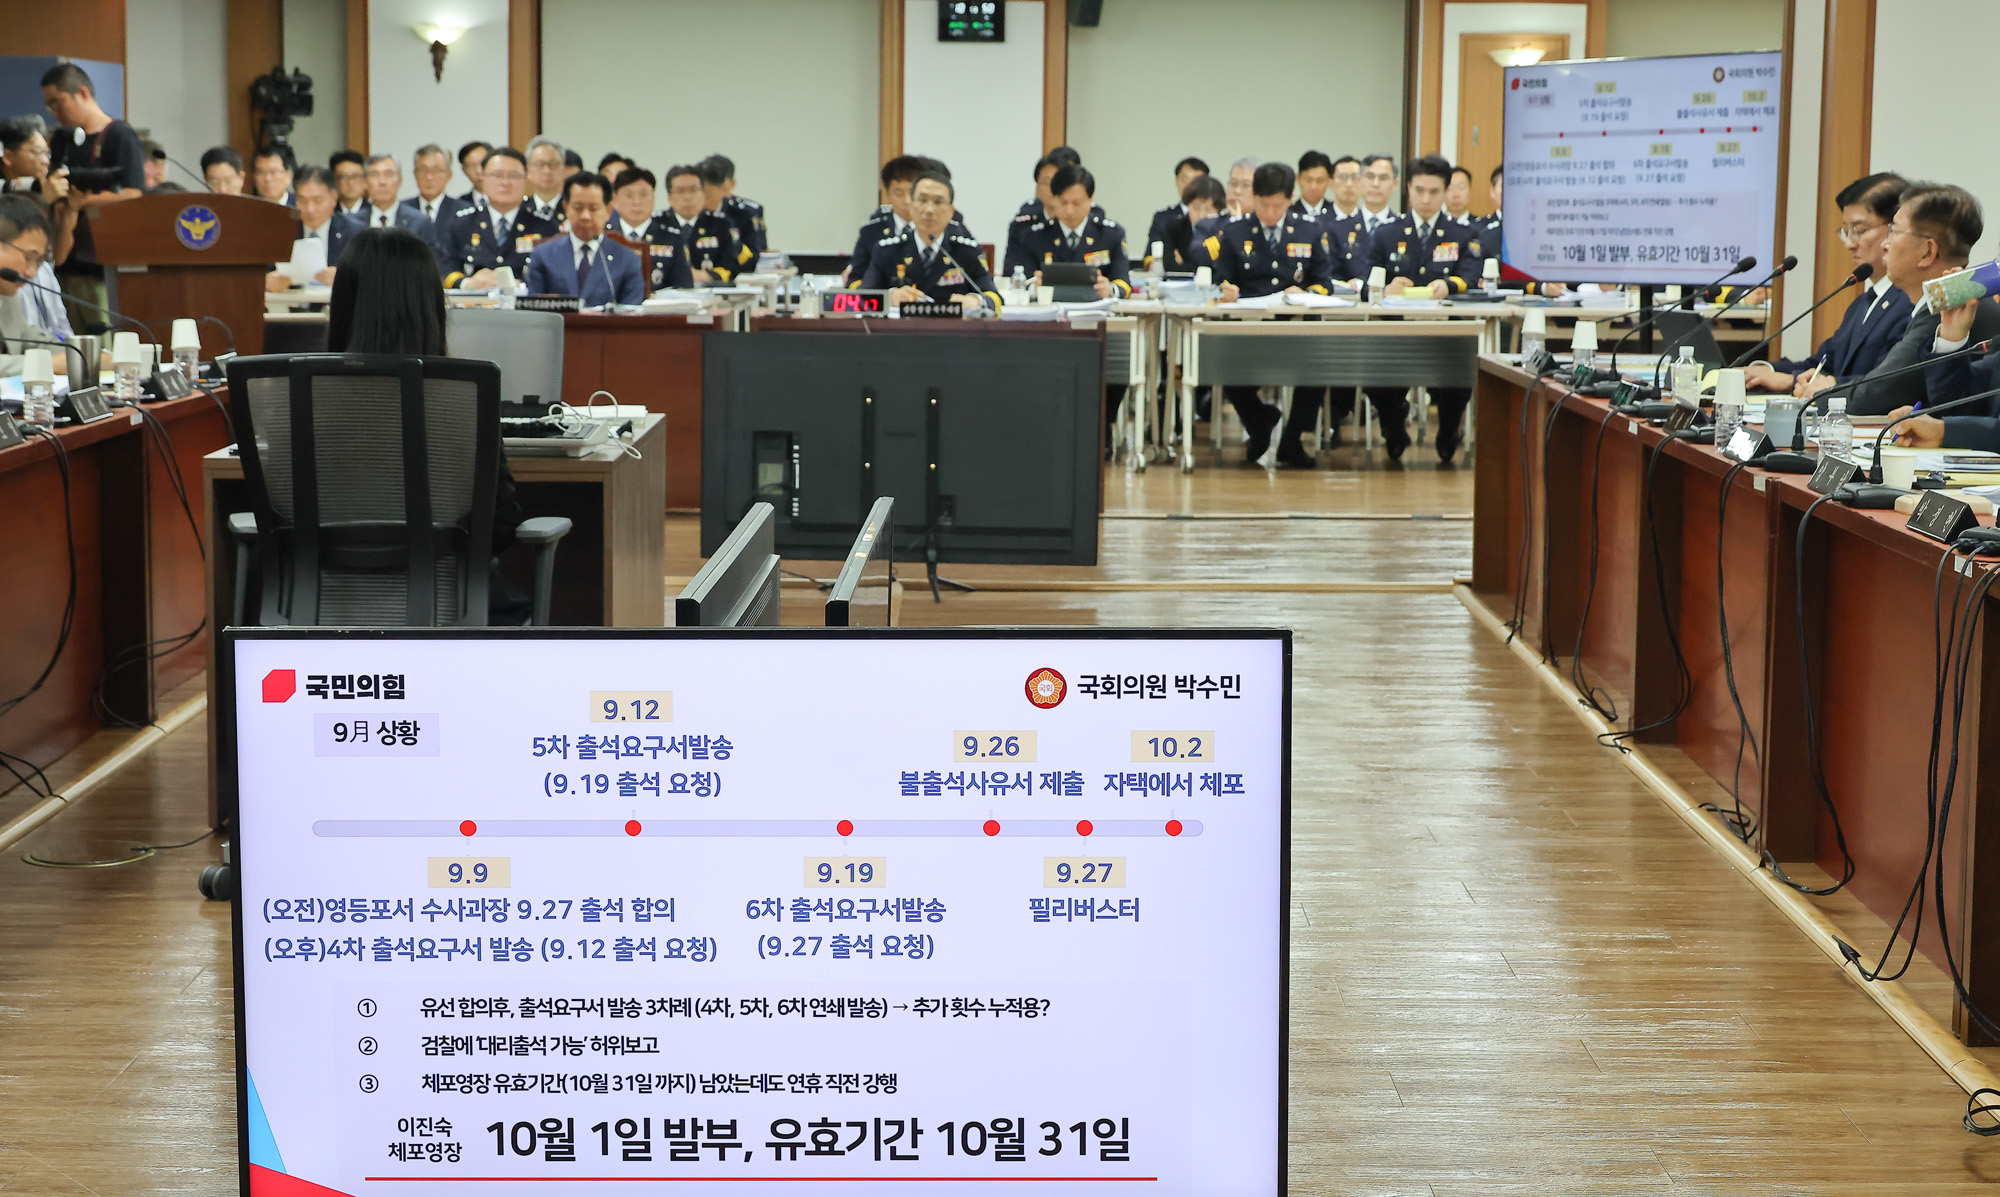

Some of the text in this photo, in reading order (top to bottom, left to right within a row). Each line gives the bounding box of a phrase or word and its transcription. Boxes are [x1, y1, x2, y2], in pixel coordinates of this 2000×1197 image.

[1563, 244, 1586, 262] 10월
[1590, 244, 1606, 262] 1일
[1637, 244, 1681, 263] 유효기간
[1685, 245, 1711, 263] 10월
[1714, 245, 1741, 264] 31일
[305, 673, 405, 700] 국민의힘
[1077, 674, 1241, 700] 국회의원 박수민
[603, 699, 660, 721] 9.12
[376, 719, 421, 746] 상황
[532, 733, 734, 761] 5차 출석요구서발송
[963, 735, 1020, 758] 9.26
[1148, 737, 1203, 759] 10.2
[544, 770, 722, 798] (9.19 출석 요청)
[898, 770, 1085, 797] 불출석사유서 제출
[1103, 771, 1246, 798] 자택에서 체포
[448, 862, 488, 884] 9.9
[817, 862, 874, 884] 9.19
[1056, 862, 1113, 884] 9.27
[263, 896, 675, 924] (오전)영등포서 수사과장 9.27 출석 합의
[746, 896, 947, 923] 6차 출석요구서발송
[1029, 897, 1140, 923] 필리버스터
[264, 936, 717, 963] (오후)4차 출석요구서 발송 (9.12 출석 요청)
[757, 933, 934, 960] (9.27 출석 요청)
[419, 997, 455, 1018] 유선
[457, 996, 515, 1019] 합의후,
[518, 996, 604, 1019] 출석요구서
[607, 997, 643, 1019] 발송
[645, 997, 692, 1018] 3차례
[694, 997, 735, 1019] (4차,
[739, 997, 773, 1019] 5차,
[777, 997, 808, 1018] 6차
[809, 997, 845, 1018] 연쇄
[847, 997, 888, 1019] 발송)
[912, 996, 949, 1018] 추가
[950, 996, 987, 1018] 횟수
[987, 997, 1051, 1019] 누적용?
[421, 1034, 474, 1057] 검찰에
[589, 1035, 660, 1056] 허위보고
[421, 1073, 492, 1095] 체포영장
[699, 1073, 786, 1094] 남았는데도
[787, 1072, 824, 1094] 연휴
[825, 1073, 860, 1094] 직전
[862, 1073, 898, 1095] 강행
[397, 1116, 453, 1138] 이진숙
[486, 1116, 1130, 1163] 10월 1일 발부, 유효기간 10월 31일
[388, 1141, 463, 1163] 체포영장
